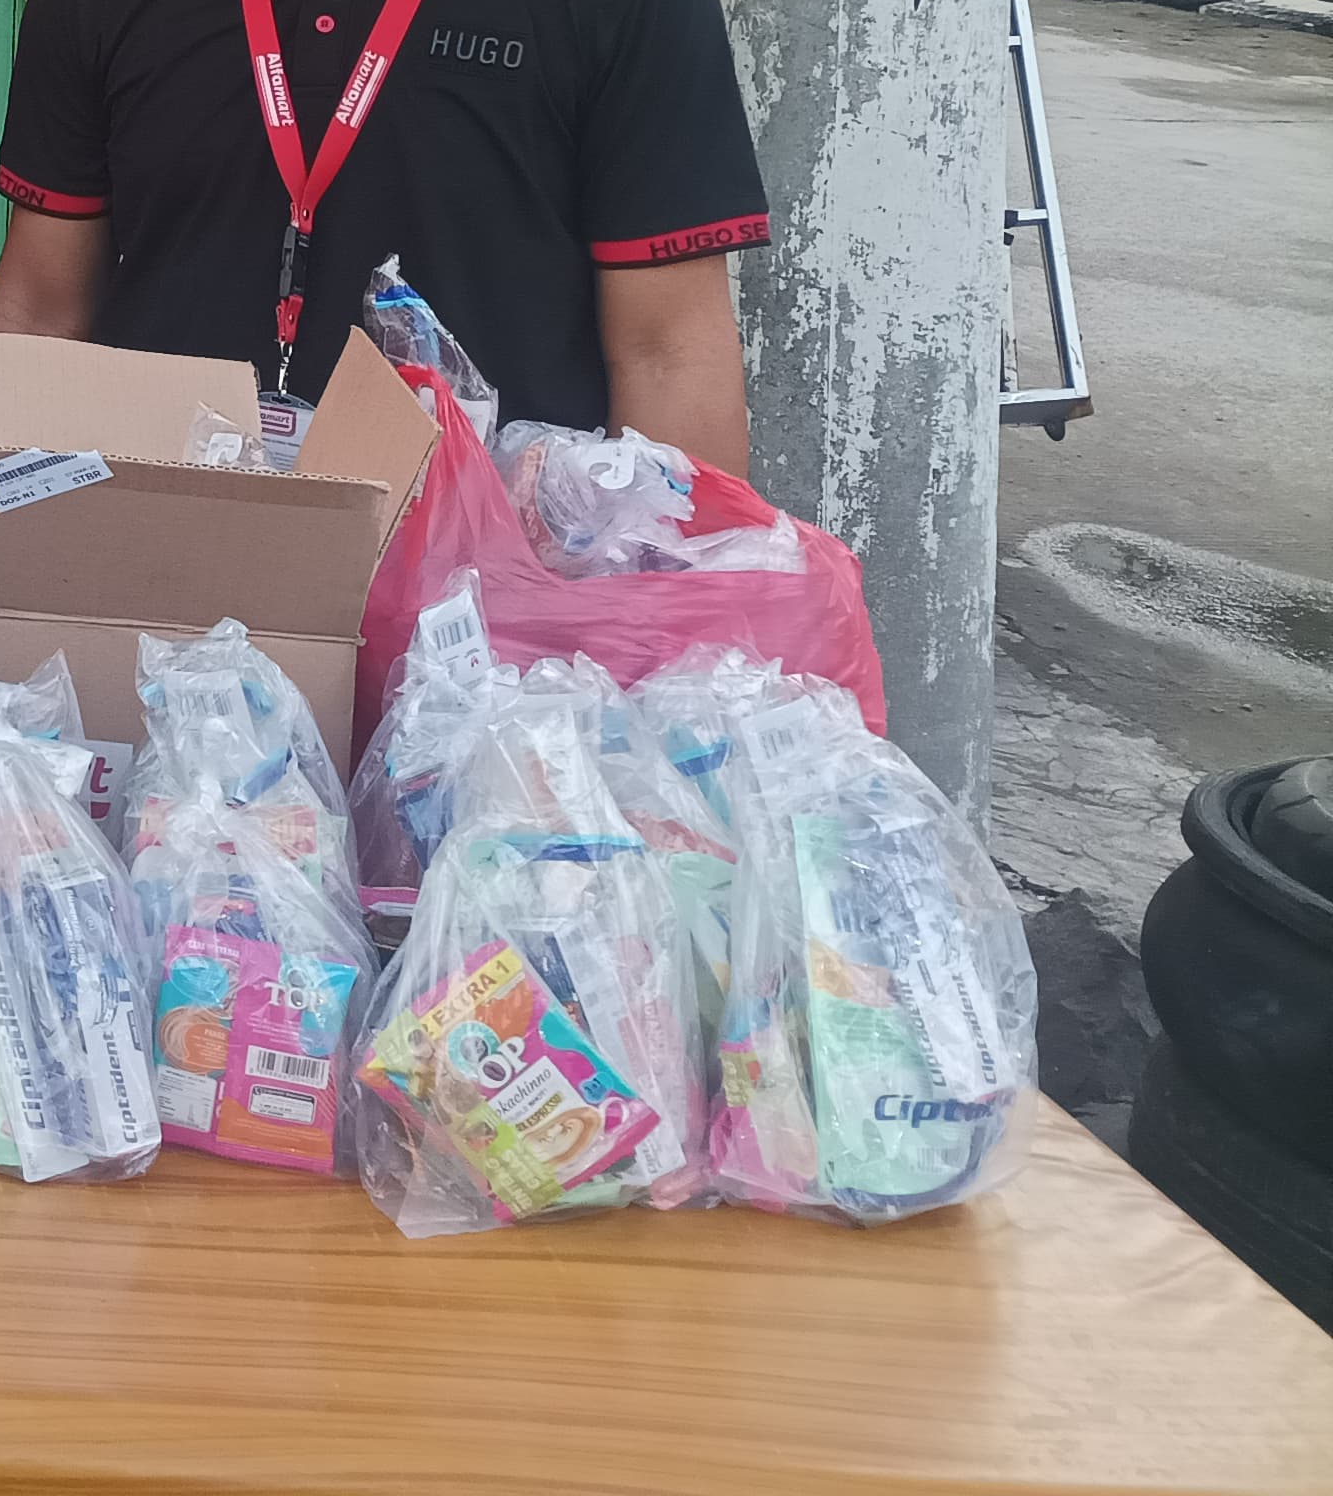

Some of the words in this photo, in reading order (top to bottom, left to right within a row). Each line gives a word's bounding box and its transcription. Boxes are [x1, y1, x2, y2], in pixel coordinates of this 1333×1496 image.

[429, 28, 524, 69] HUGO
[267, 53, 294, 127] Alfamart
[335, 50, 377, 125] Alfamart
[649, 228, 733, 259] HUGO
[72, 470, 102, 485] STBR
[436, 970, 498, 1028] EXTRA
[102, 1030, 139, 1144] Ciptadent
[476, 1035, 528, 1089] OP
[497, 1068, 552, 1118] okachinno
